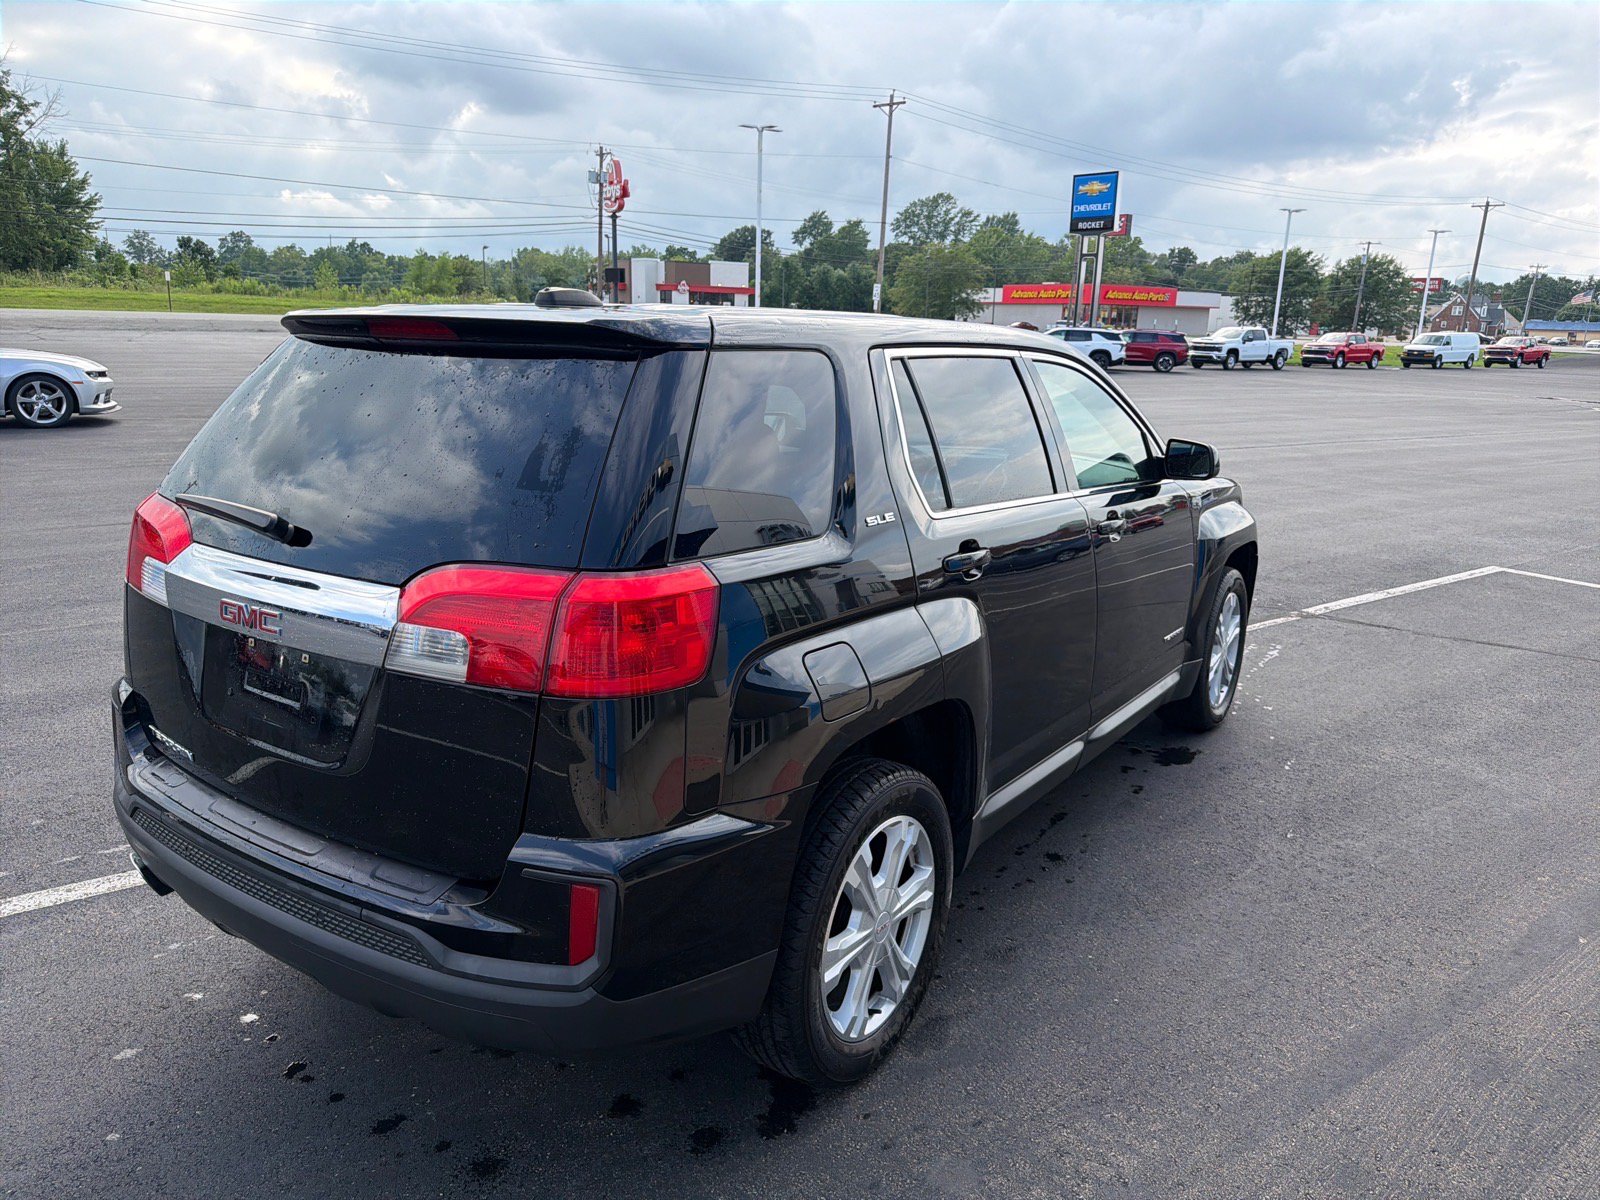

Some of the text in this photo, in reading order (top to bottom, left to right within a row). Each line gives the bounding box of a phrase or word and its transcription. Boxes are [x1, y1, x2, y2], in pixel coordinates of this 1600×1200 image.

[1073, 202, 1112, 212] CHEVROLET
[1078, 221, 1104, 230] ROCKET
[1011, 289, 1038, 299] Advance
[1038, 289, 1055, 299] Auto
[1106, 290, 1165, 301] Advance Auto Parts
[865, 512, 896, 527] SLE
[219, 598, 283, 636] GMC
